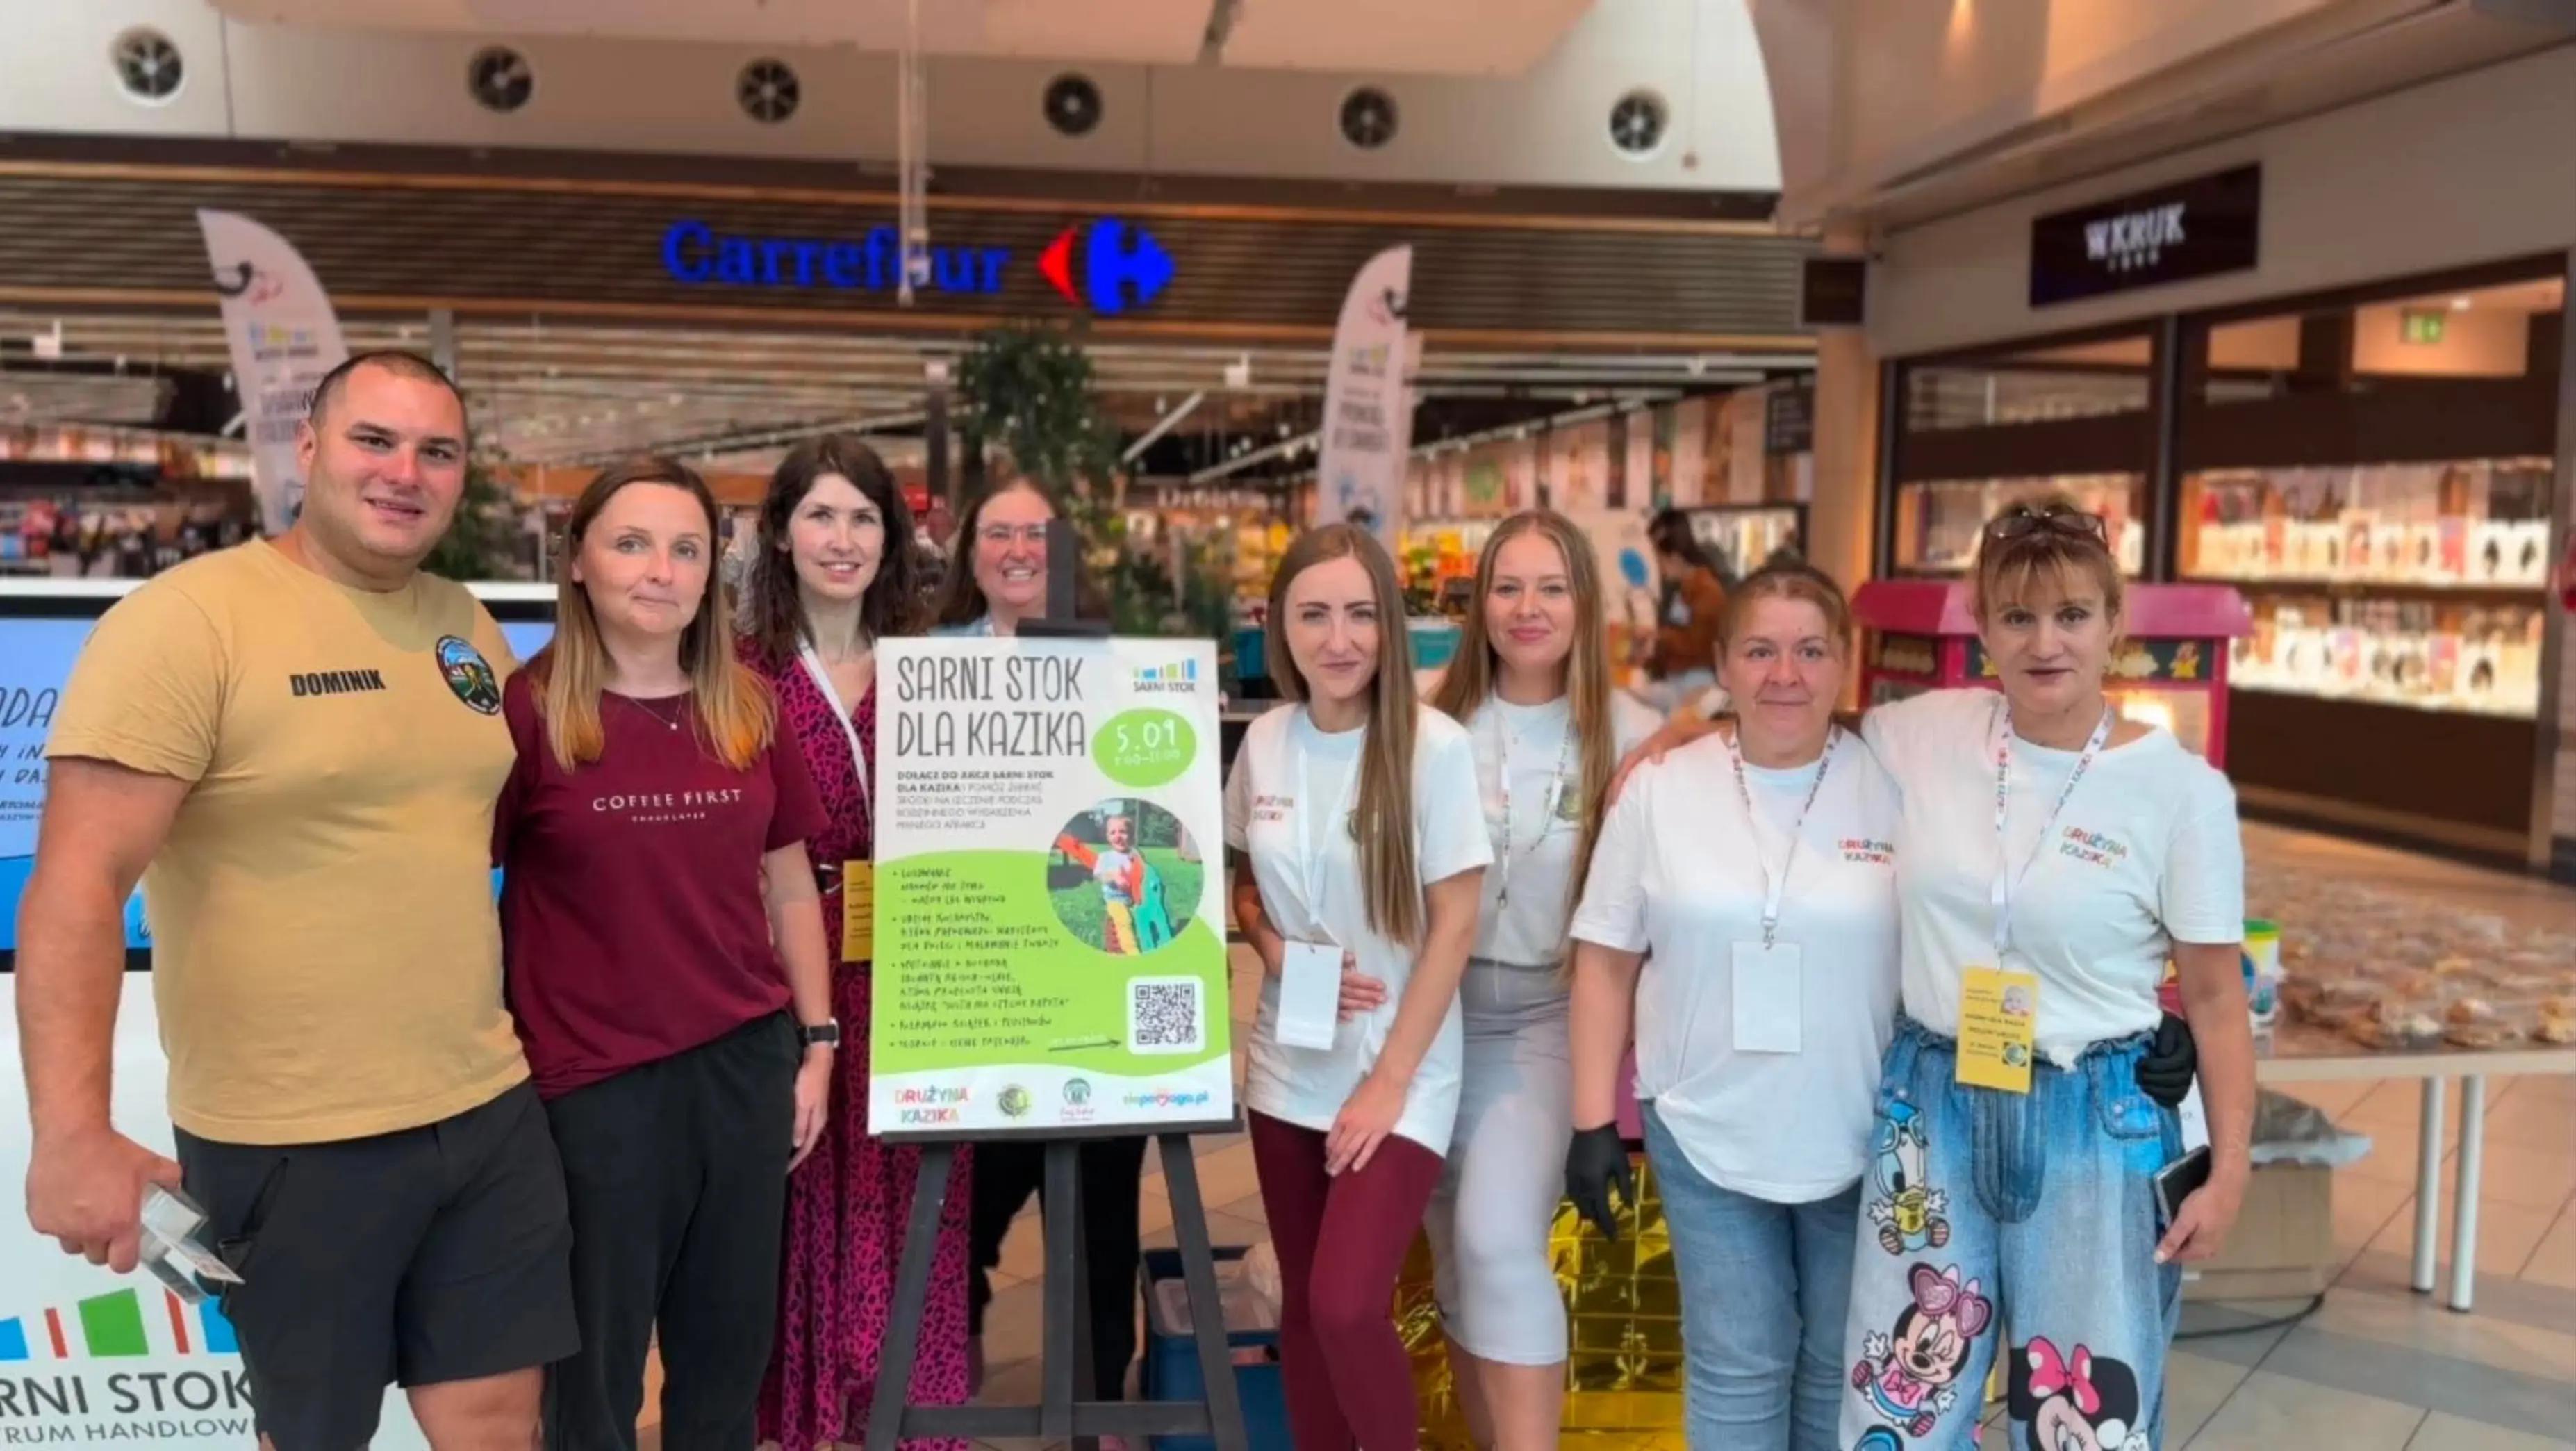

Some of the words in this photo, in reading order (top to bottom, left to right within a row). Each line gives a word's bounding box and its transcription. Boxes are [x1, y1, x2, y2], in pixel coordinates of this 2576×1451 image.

[289, 669, 386, 696] DOMINIK
[897, 655, 993, 702] SARNI
[1006, 655, 1084, 702] STOK
[1133, 681, 1164, 693] SARNI
[1168, 681, 1196, 693] STOK
[897, 710, 955, 757] DLA
[967, 710, 1085, 757] KAZIKA
[897, 782, 917, 792] DLA
[919, 782, 961, 792] KAZIKA
[592, 793, 674, 811] COFFEE
[683, 789, 742, 805] FIRST
[894, 1083, 969, 1104] DRUŻYNA
[900, 1109, 960, 1124] KAZIKA
[107, 1370, 256, 1415] STOK
[0, 1423, 76, 1444] RUM
